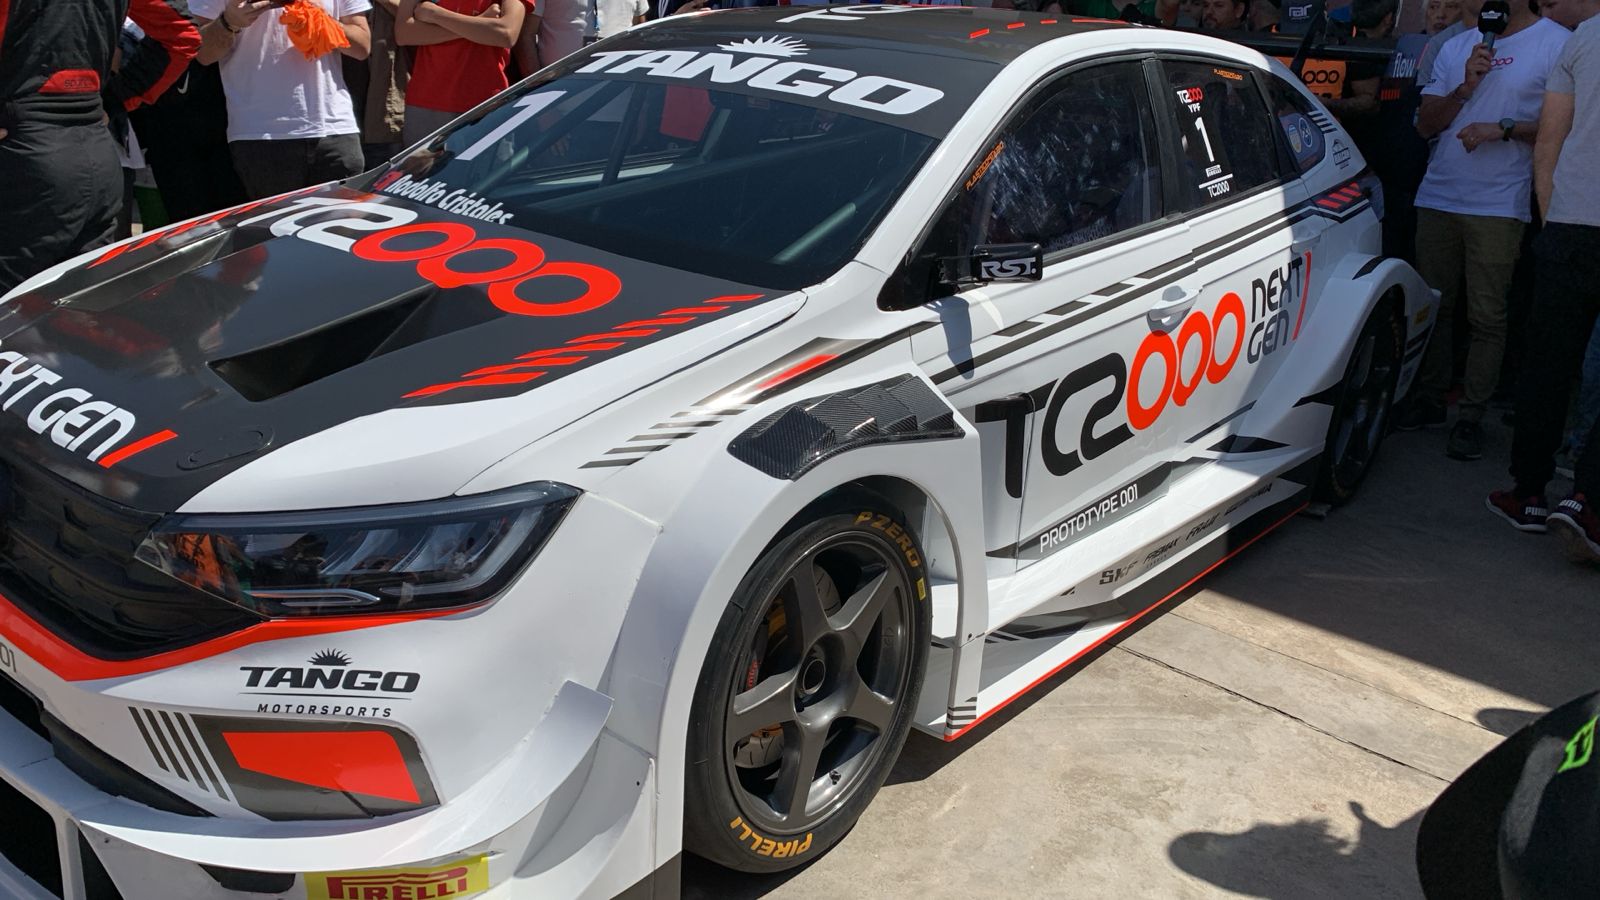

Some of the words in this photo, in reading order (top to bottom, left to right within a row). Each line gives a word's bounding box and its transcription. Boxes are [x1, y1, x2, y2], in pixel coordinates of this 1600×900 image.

[574, 50, 944, 115] TANGO
[1177, 87, 1203, 104] TC2000
[455, 90, 566, 161] 1
[1188, 103, 1201, 113] YPF
[1195, 116, 1215, 162] 1
[384, 174, 447, 204] Rodolfo
[437, 188, 515, 225] Cristales
[1207, 181, 1230, 198] TC2000
[236, 196, 622, 316] TC2000
[1252, 256, 1304, 324] NEXT
[1247, 311, 1290, 364] GEN
[975, 292, 1246, 499] TC2000
[27, 388, 136, 462] GEN
[1040, 494, 1118, 553] PROTOTYPE
[1120, 483, 1139, 508] 001
[0, 642, 16, 673] 01
[240, 666, 421, 693] TANGO
[257, 703, 392, 718] MOTORSPORTS
[729, 816, 813, 857] PIRELLI
[326, 867, 468, 900] PIRELLI
